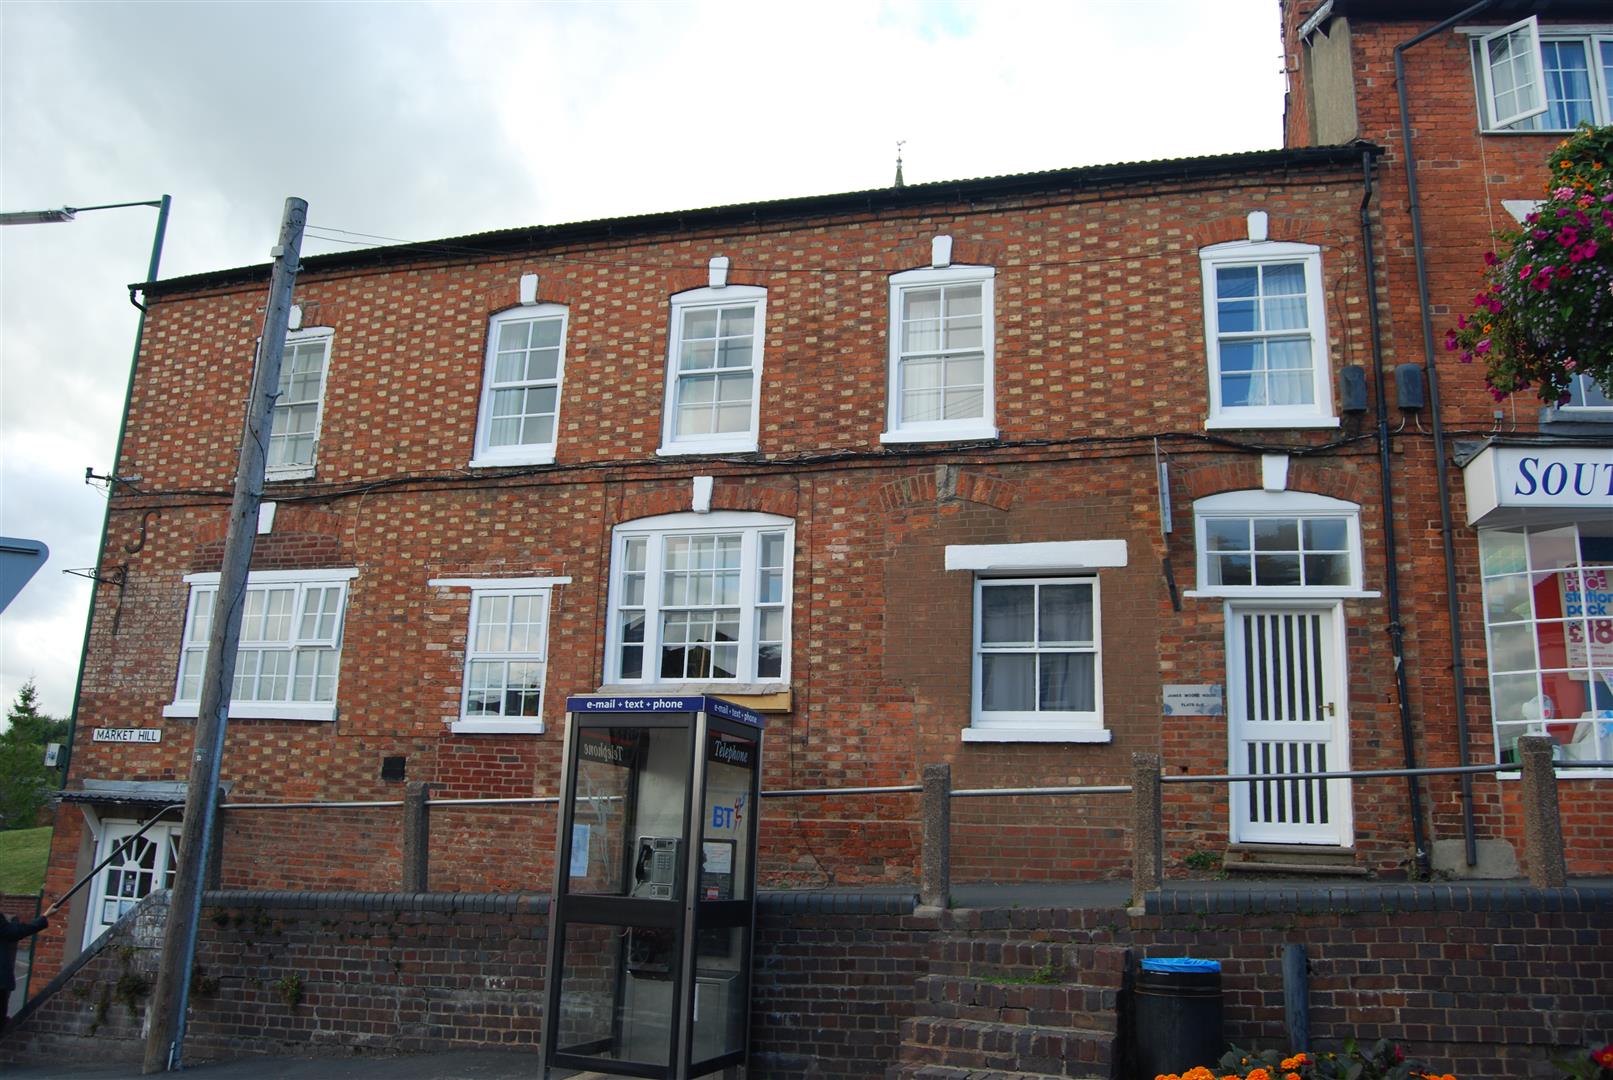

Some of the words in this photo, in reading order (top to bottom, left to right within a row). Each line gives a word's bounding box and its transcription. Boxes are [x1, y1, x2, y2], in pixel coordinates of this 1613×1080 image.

[1565, 577, 1609, 591] PRCE
[586, 699, 616, 709] e-mail
[624, 700, 644, 709] text
[652, 699, 683, 710] phone
[96, 730, 134, 741] MARKET
[138, 731, 157, 741] HILL
[714, 740, 749, 763] Telephone
[712, 805, 735, 829] BT
